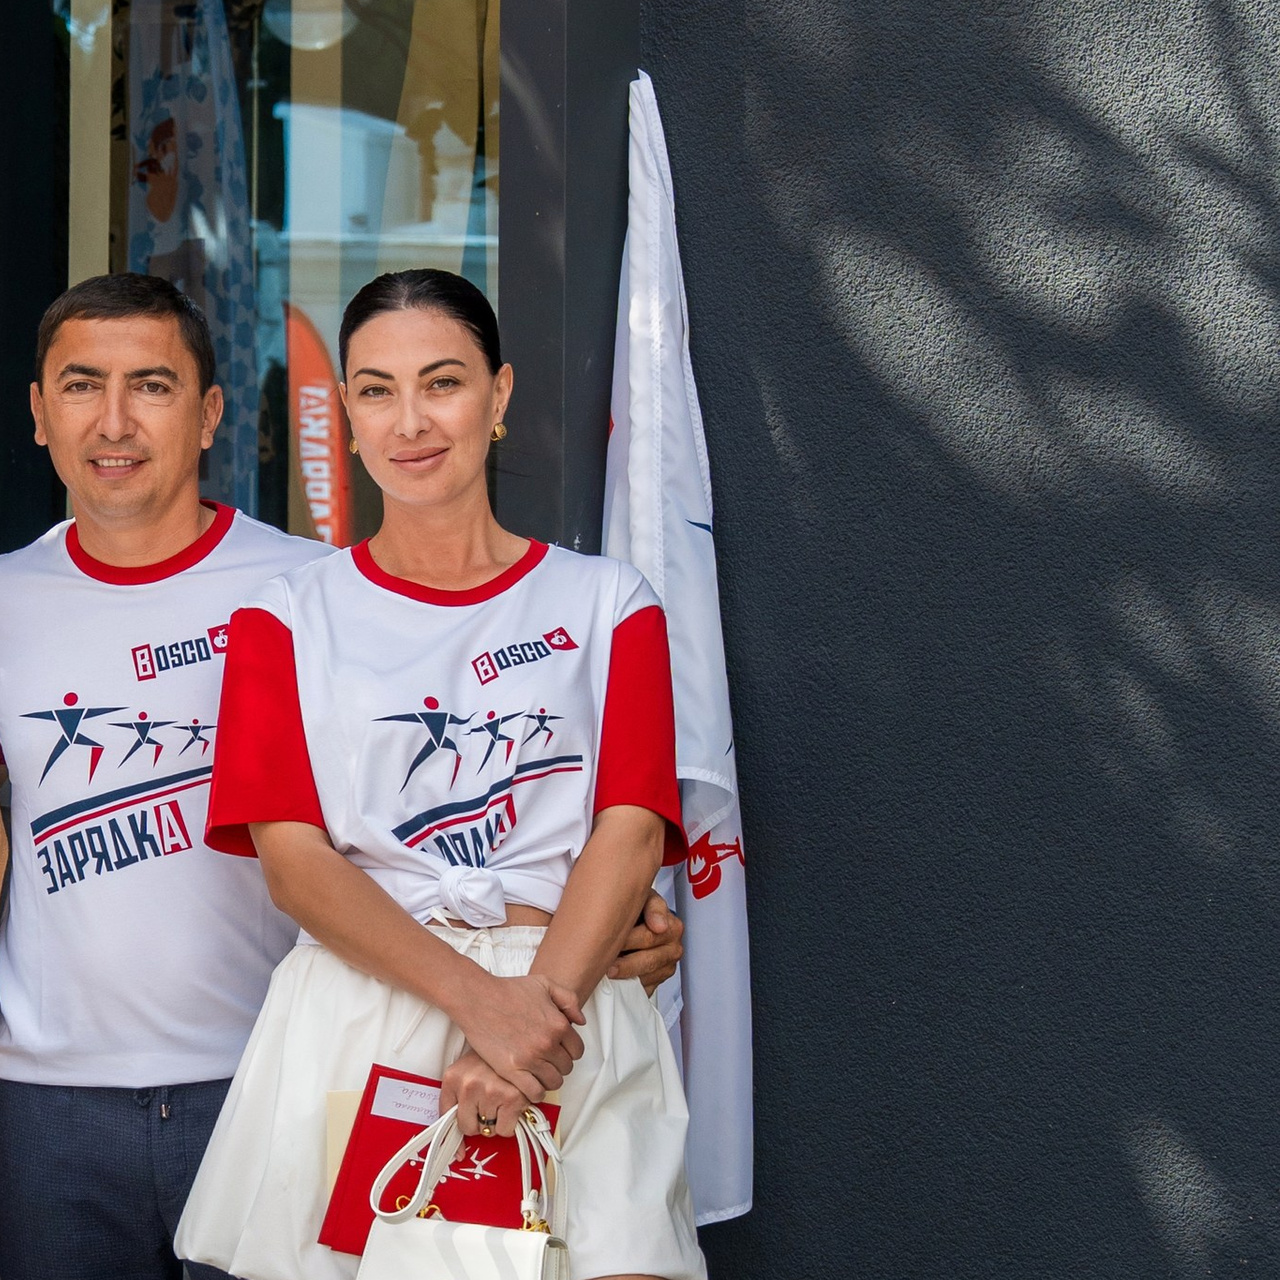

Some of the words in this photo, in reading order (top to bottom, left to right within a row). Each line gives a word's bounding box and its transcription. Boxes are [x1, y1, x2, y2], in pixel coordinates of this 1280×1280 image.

[131, 635, 212, 681] BOSCO
[471, 639, 551, 686] BOSCO
[36, 799, 193, 895] ЗАРЯДКА
